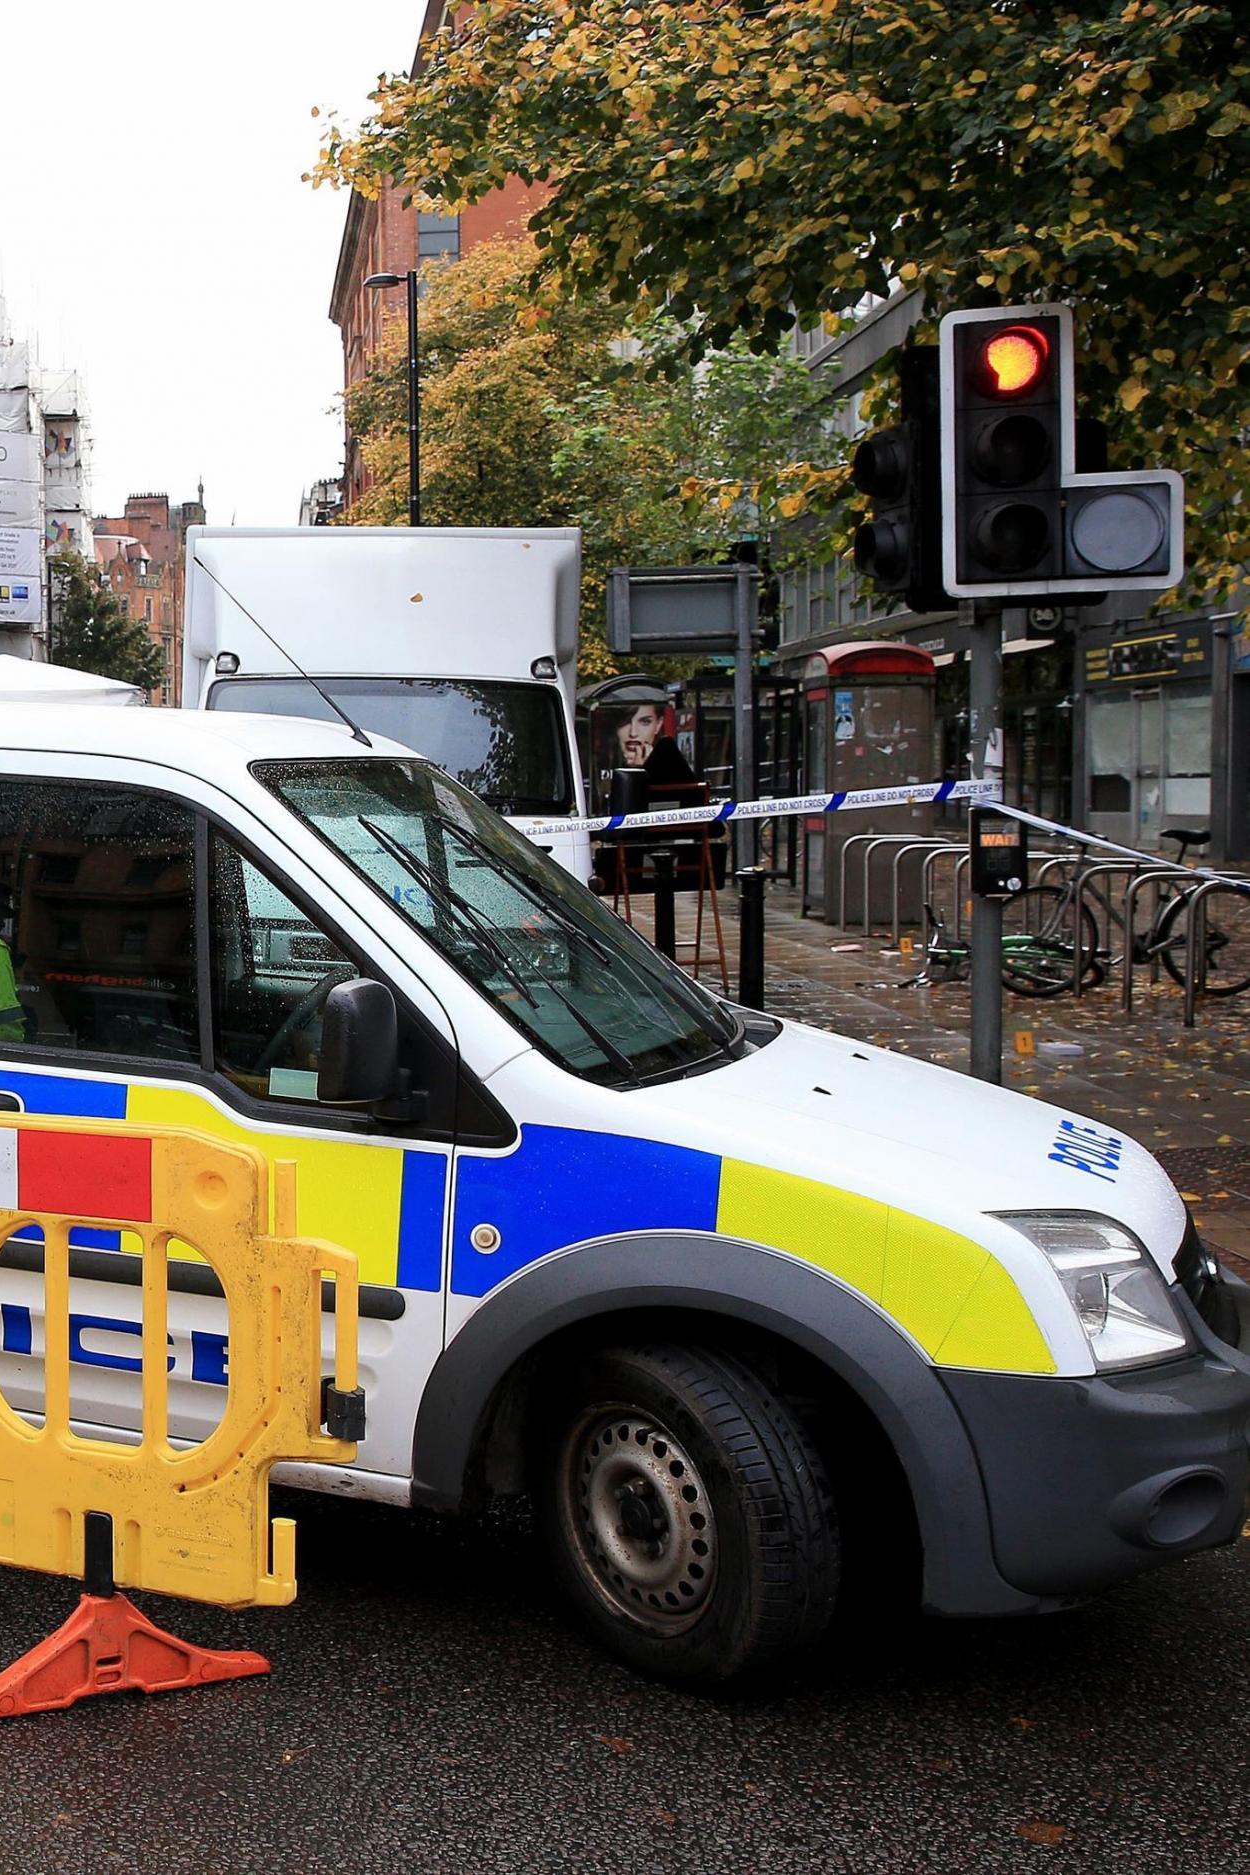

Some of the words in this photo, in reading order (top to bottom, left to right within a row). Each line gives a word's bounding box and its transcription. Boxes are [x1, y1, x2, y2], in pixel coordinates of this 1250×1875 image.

[848, 794, 870, 804] POLICE
[872, 793, 887, 802] LINE
[887, 792, 898, 801] DO
[911, 788, 934, 799] CROSS
[955, 784, 978, 795] POLICE
[978, 784, 994, 794] LINE
[738, 804, 762, 815] POLICE
[762, 803, 778, 812] LINE
[778, 802, 789, 812] DO
[790, 801, 802, 810] NOT
[804, 798, 826, 809] CROSS
[626, 815, 651, 826] POLICE
[651, 814, 666, 824] LINE
[667, 812, 677, 822] DO
[678, 812, 692, 821] NOT
[693, 808, 716, 819] CROSS
[538, 826, 553, 834] LINE
[554, 825, 565, 833] DO
[566, 824, 580, 832] NOT
[580, 821, 605, 831] CROSS
[1048, 1119, 1123, 1183] POLICE
